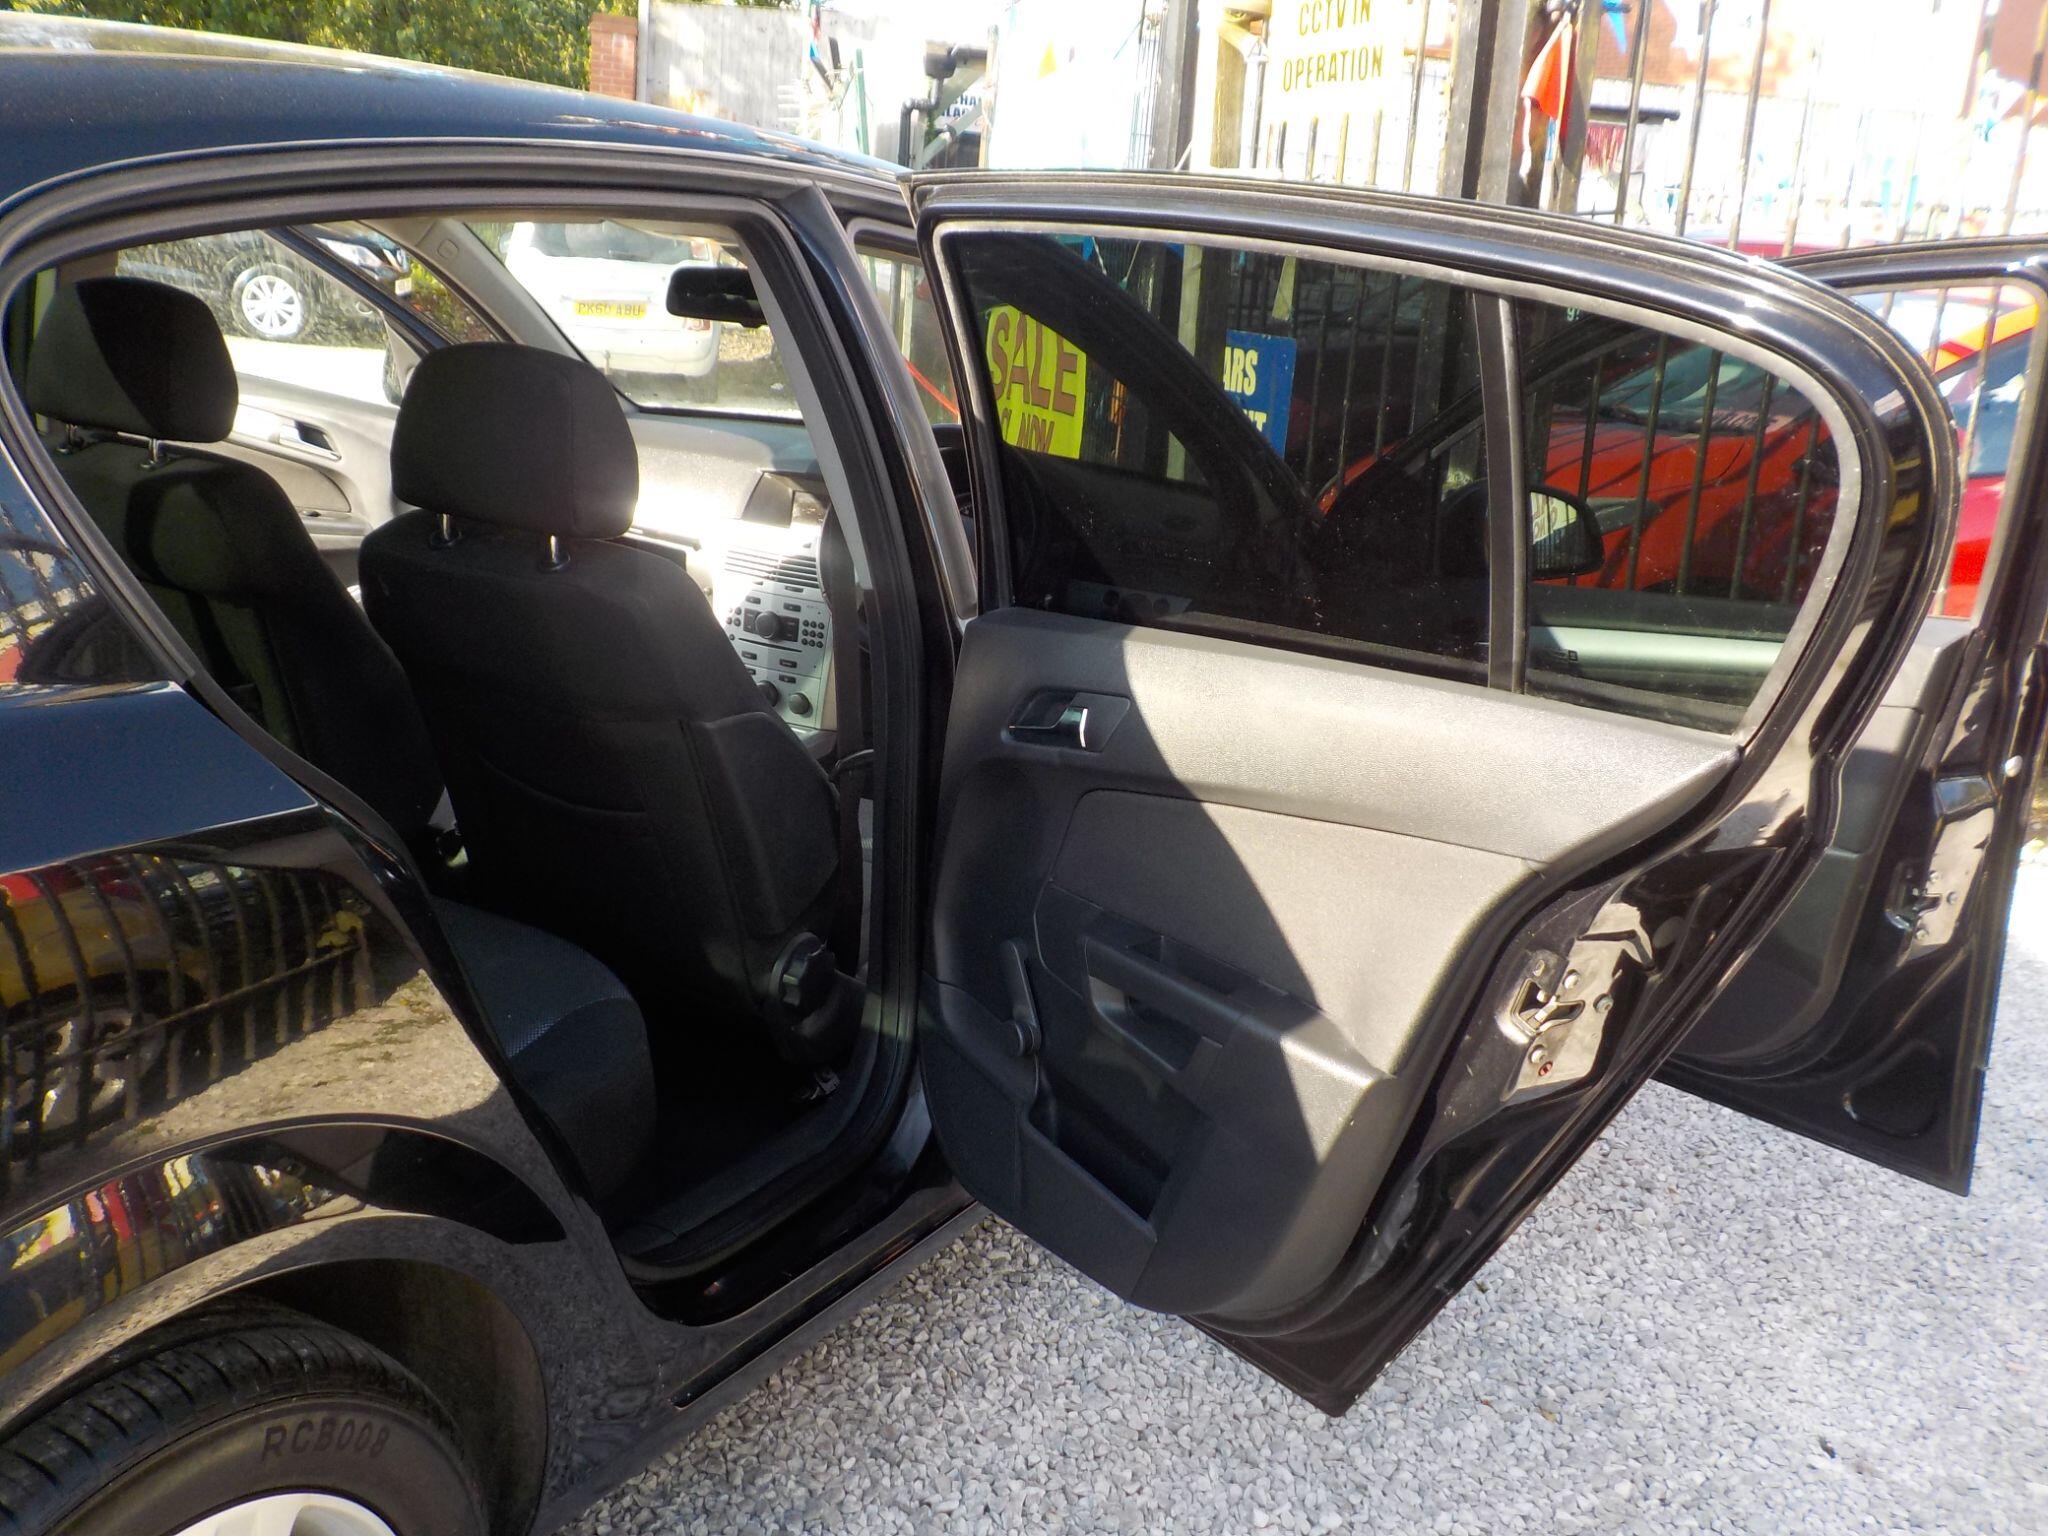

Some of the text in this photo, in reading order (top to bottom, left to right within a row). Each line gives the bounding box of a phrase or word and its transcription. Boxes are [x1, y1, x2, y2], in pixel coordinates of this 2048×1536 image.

[1299, 0, 1371, 36] CCTV IN
[1283, 45, 1384, 92] OPERATION
[991, 311, 1077, 417] SALE
[261, 1416, 392, 1462] RCB008
